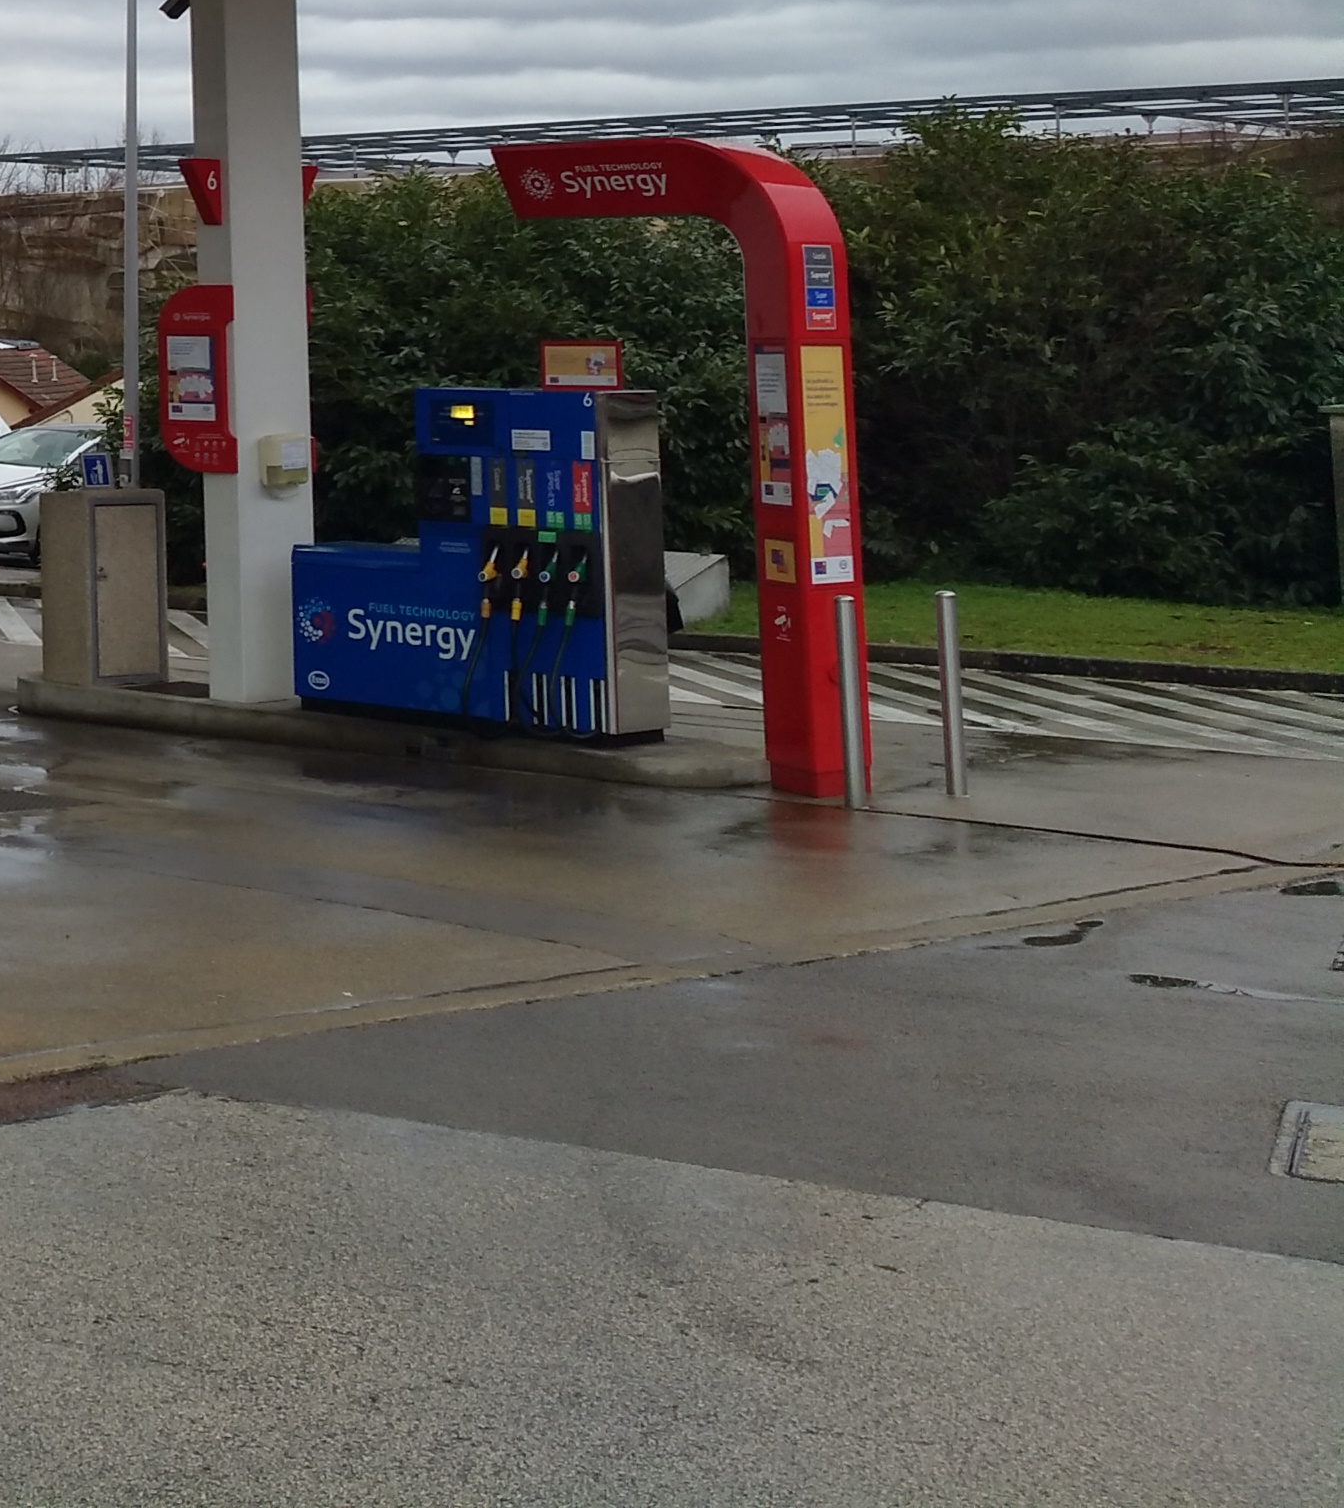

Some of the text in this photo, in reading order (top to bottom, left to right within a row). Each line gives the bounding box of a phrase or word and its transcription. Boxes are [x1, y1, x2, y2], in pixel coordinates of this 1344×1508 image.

[574, 162, 663, 173] FUEL TECHNOLOGY
[207, 170, 217, 190] 6
[560, 171, 667, 199] Synergy
[583, 392, 593, 407] 6
[369, 602, 476, 621] FUEL TECHNOLOGY
[348, 608, 476, 661] Synergy
